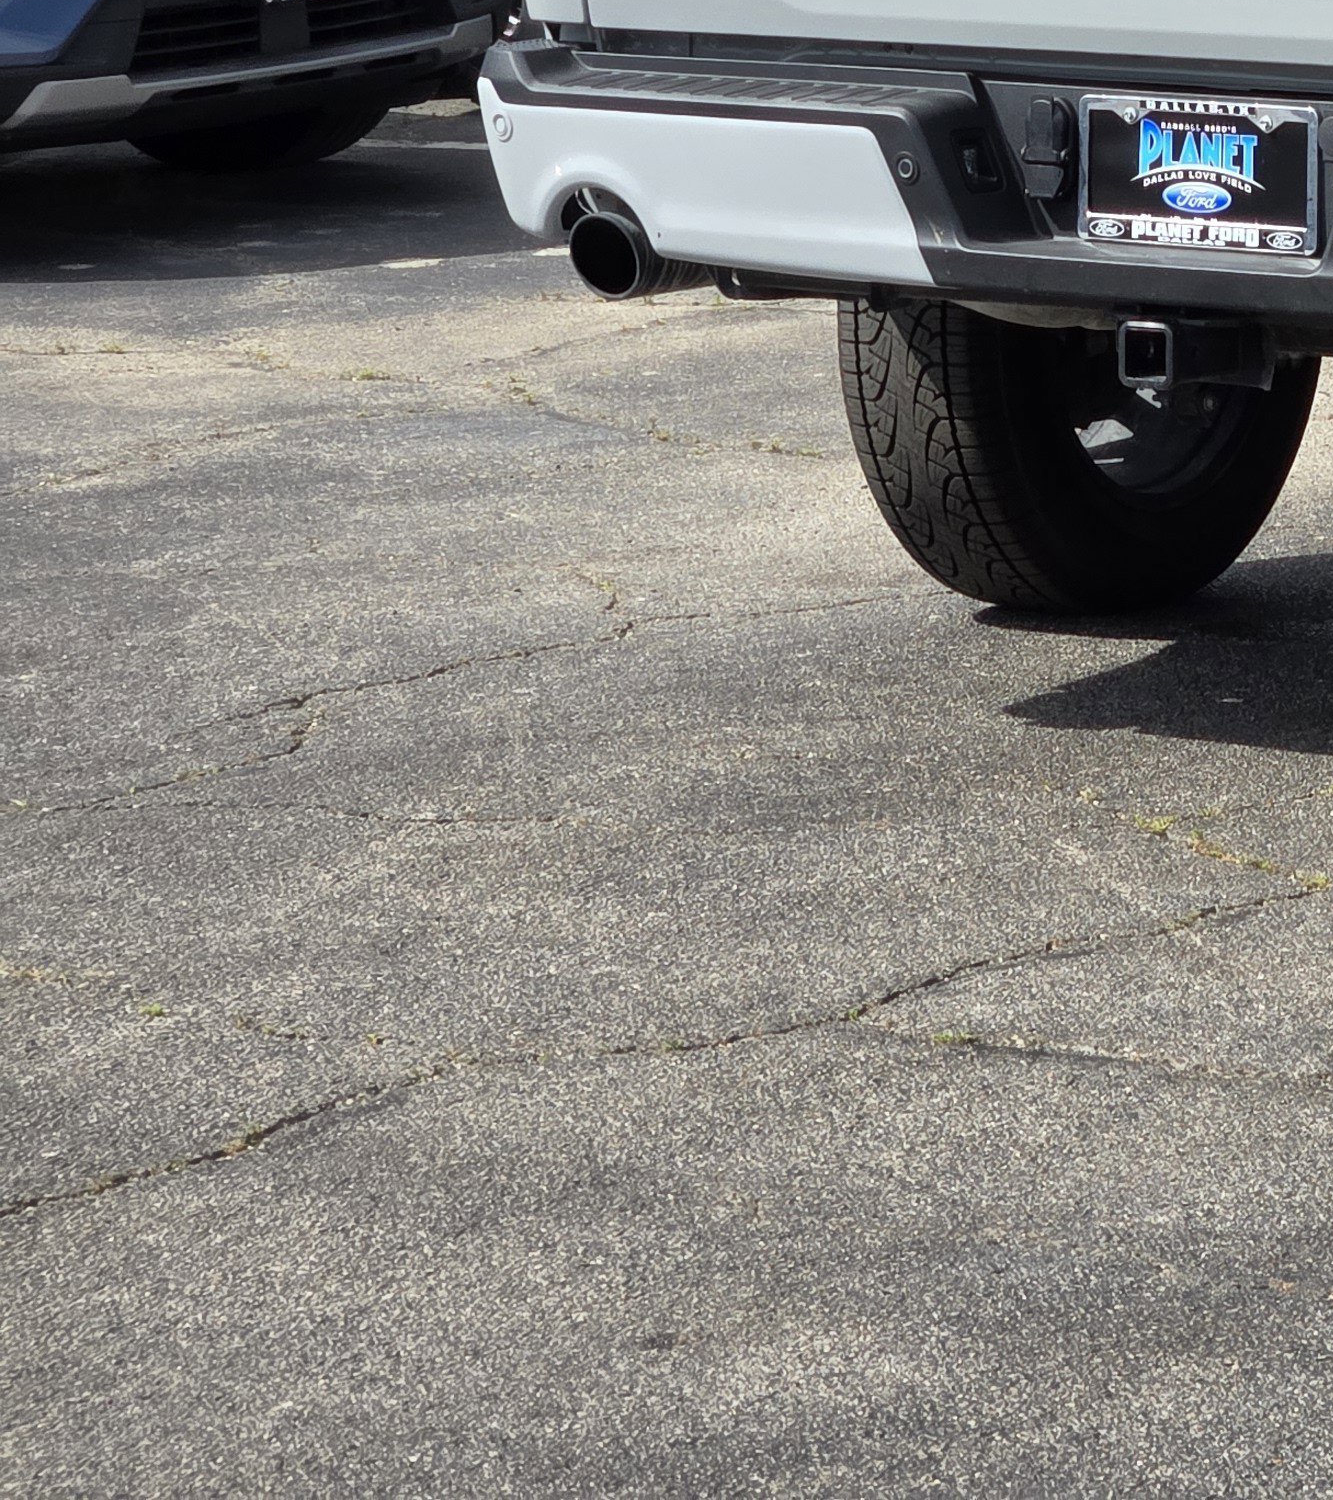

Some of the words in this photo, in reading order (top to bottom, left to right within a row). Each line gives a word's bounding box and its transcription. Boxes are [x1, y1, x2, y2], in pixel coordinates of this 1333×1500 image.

[1138, 118, 1258, 182] PLANET
[1142, 170, 1184, 187] DALLAS
[1188, 170, 1217, 182] LOVE
[1220, 175, 1252, 194] FIELD
[1175, 187, 1218, 210] Ford
[1130, 220, 1205, 240] PLANET
[1208, 225, 1260, 248] FORD
